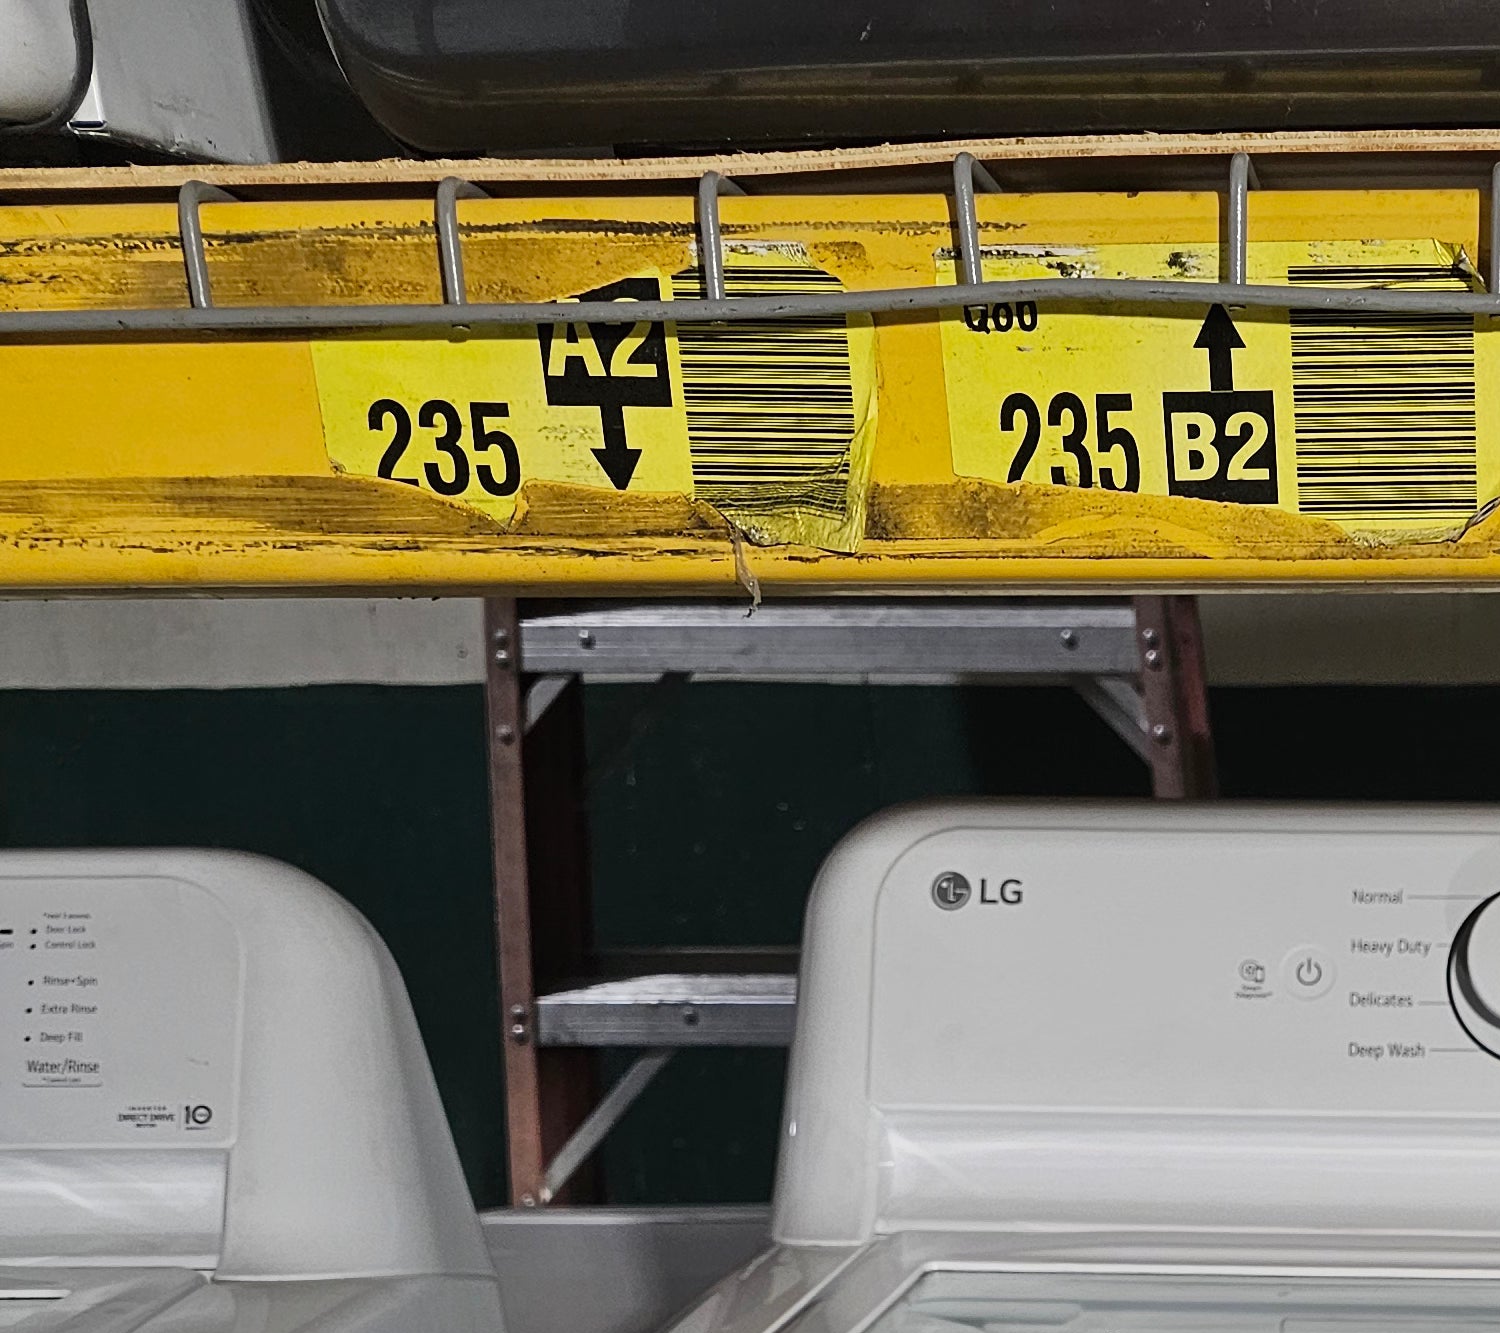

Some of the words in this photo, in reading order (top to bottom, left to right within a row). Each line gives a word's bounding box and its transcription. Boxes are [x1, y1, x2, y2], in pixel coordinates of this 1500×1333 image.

[547, 298, 659, 377] A2
[368, 398, 521, 497] 235
[1000, 391, 1140, 493] 235
[1169, 410, 1273, 482] B2
[980, 878, 1023, 905] LG
[1352, 888, 1403, 904] Normal
[1350, 938, 1394, 959] Heavy
[1397, 938, 1432, 958] Duty
[40, 1002, 68, 1015] Extra
[71, 1002, 98, 1015] Rinse
[1349, 991, 1414, 1007] Delicates
[40, 1031, 66, 1045] Deep
[1347, 1042, 1385, 1061] Deep
[1387, 1042, 1426, 1058] Wash
[26, 1058, 100, 1075] Water/Rinse
